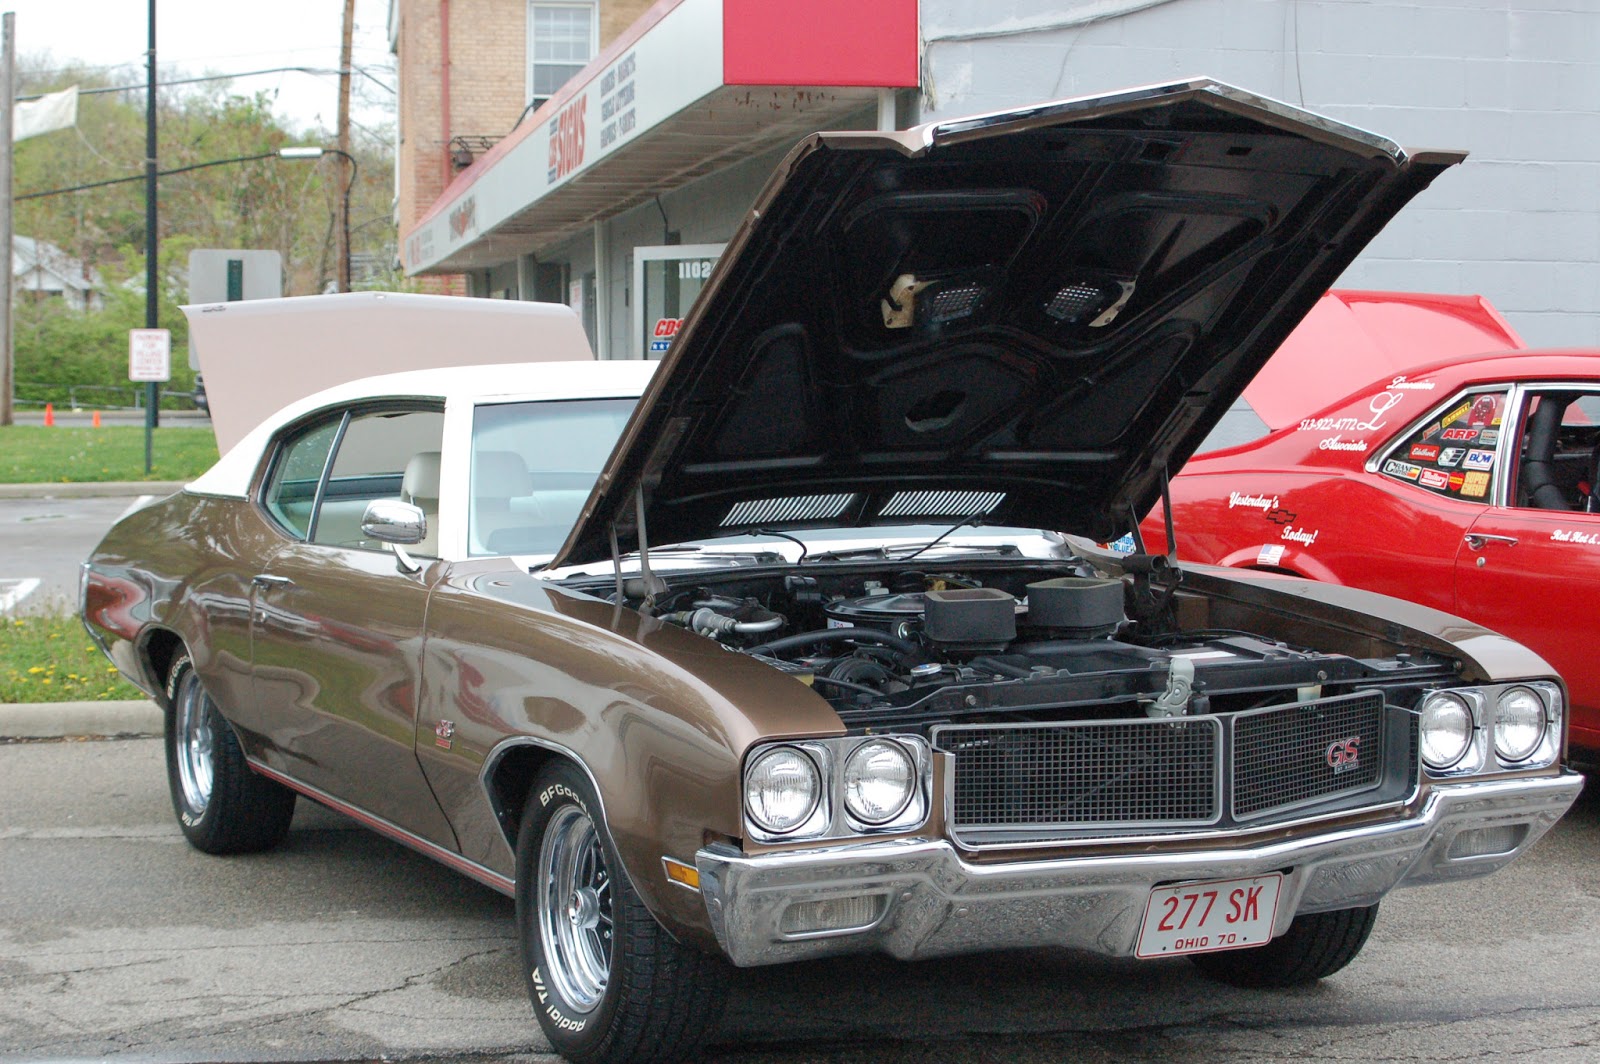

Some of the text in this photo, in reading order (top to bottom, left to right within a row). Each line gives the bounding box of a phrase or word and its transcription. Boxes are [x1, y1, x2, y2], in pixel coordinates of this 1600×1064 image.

[557, 93, 587, 180] SIGNS
[678, 261, 711, 279] 1102
[1297, 418, 1358, 431] 513-922-4772
[1441, 428, 1479, 441] ARP
[1319, 434, 1367, 452] Associates
[1229, 491, 1279, 512] Yesterday's
[1281, 526, 1318, 547] Today!
[1325, 736, 1360, 767] GS
[1157, 885, 1264, 932] 277 SK
[1174, 933, 1237, 950] OHIO 70
[531, 966, 549, 1004] T/A
